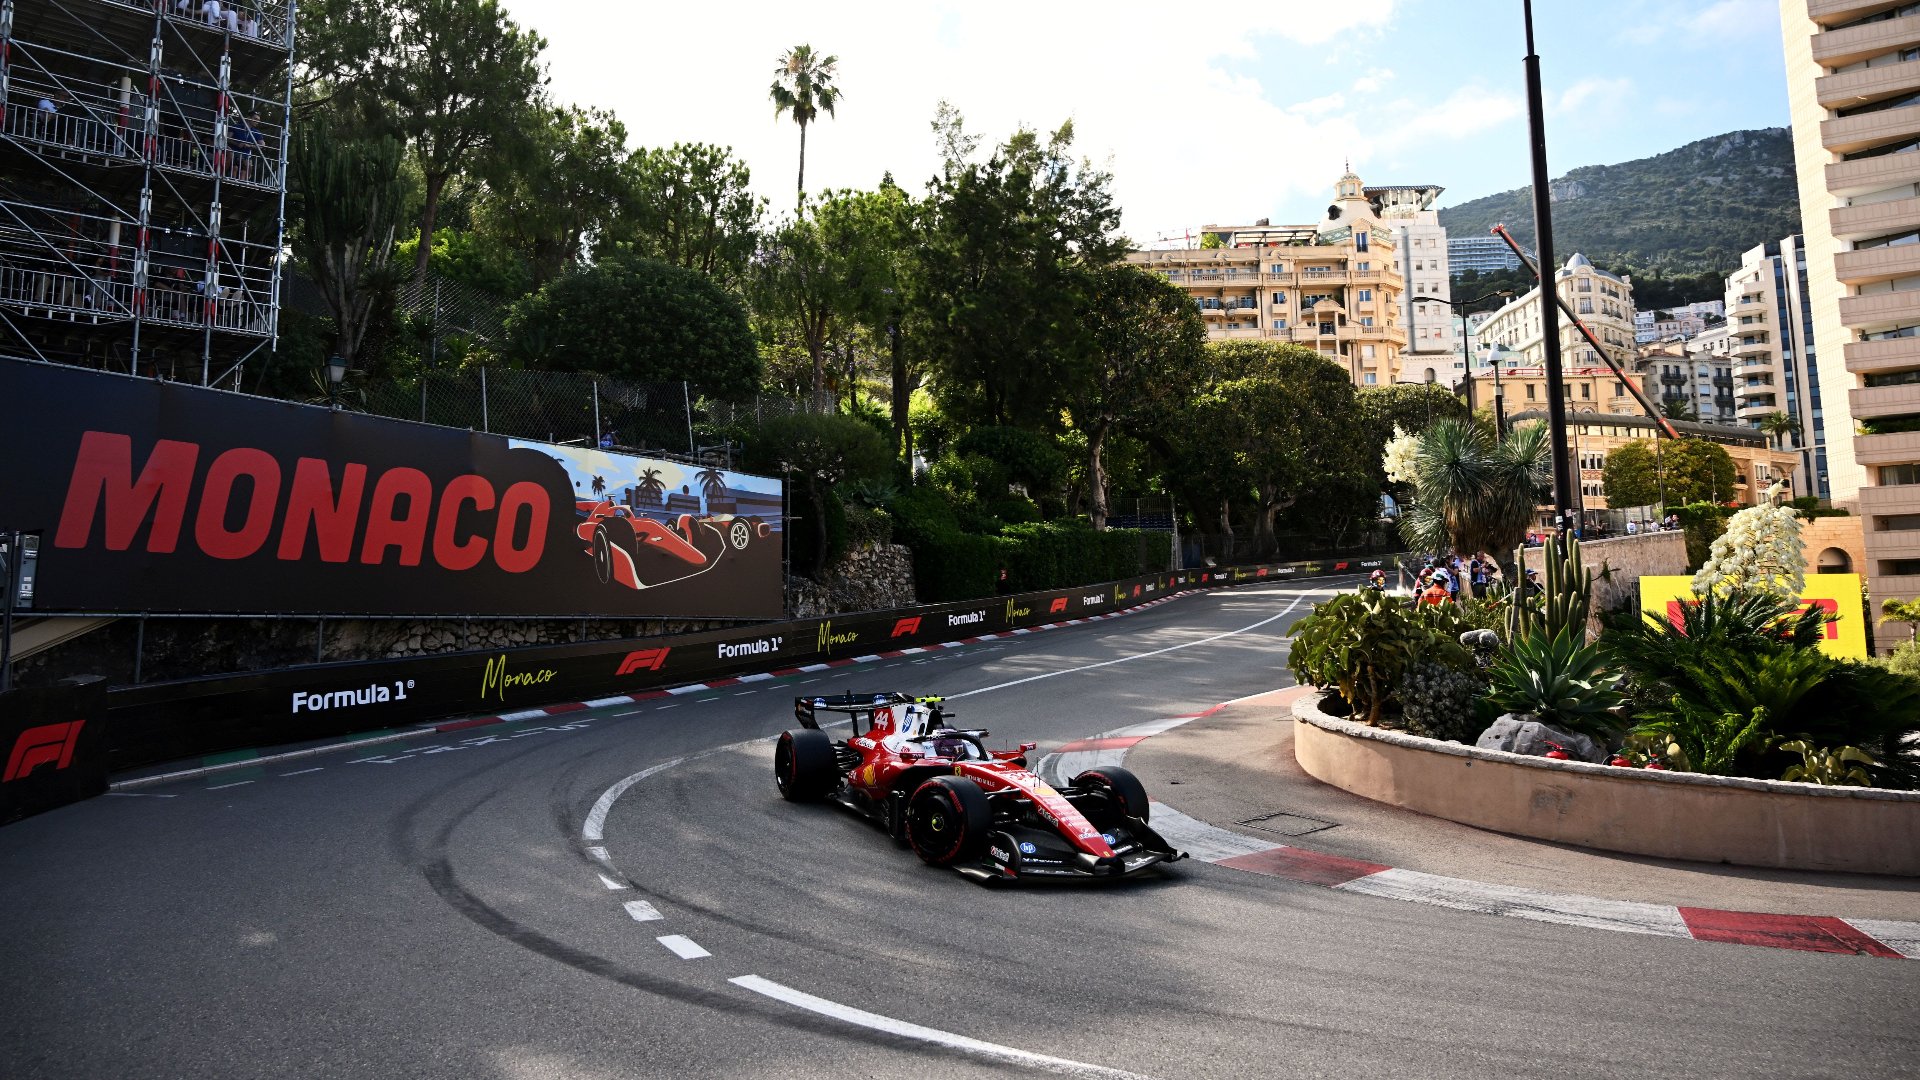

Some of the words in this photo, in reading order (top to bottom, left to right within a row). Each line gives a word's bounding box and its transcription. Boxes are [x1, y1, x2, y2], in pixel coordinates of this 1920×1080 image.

[55, 431, 551, 573] MONACO
[891, 616, 922, 638] F1
[949, 611, 979, 627] Formula
[718, 639, 769, 659] Formula
[818, 620, 858, 655] Monaco
[615, 647, 671, 676] F1
[481, 654, 558, 701] Monaco
[292, 684, 389, 714] Formula
[875, 711, 889, 731] 44
[3, 719, 86, 782] F1
